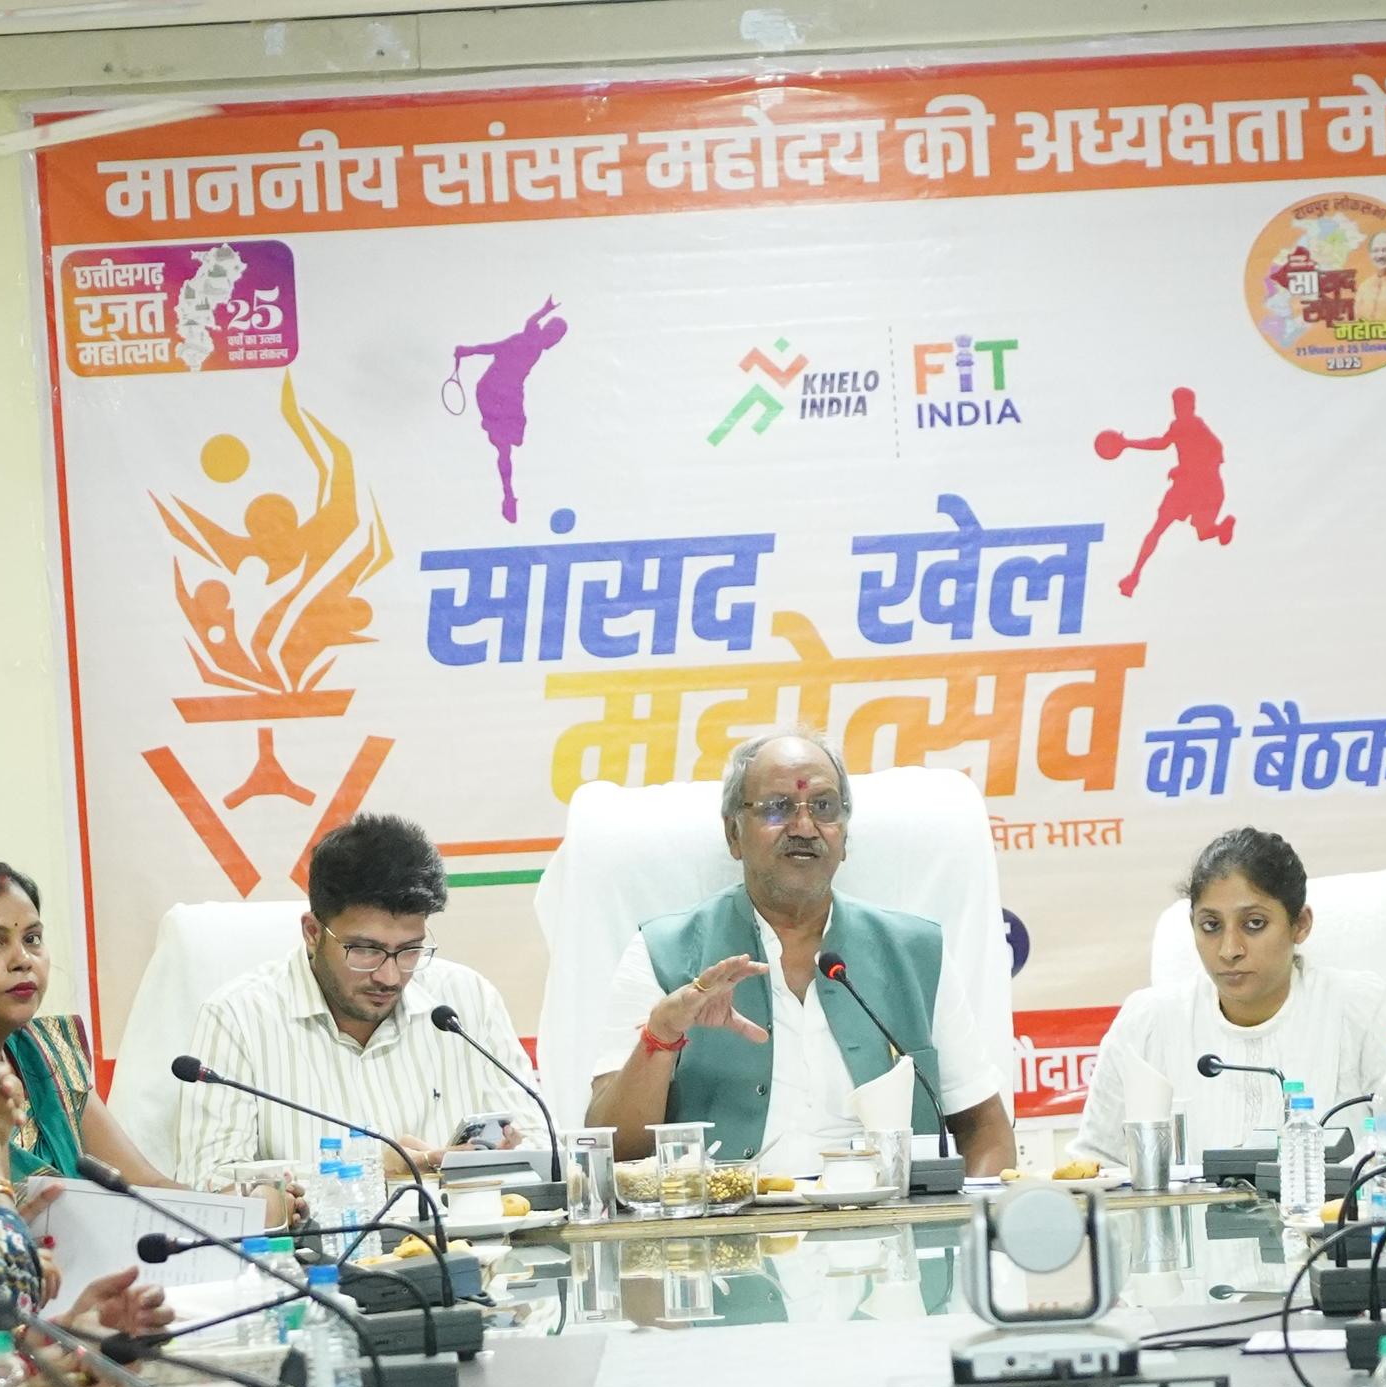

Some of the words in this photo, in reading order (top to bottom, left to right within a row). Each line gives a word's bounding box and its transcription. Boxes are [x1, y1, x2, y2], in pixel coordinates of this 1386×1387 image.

[97, 129, 404, 220] माननीय
[413, 121, 630, 207] सांसद
[637, 104, 886, 192] महोदय
[895, 93, 997, 180] की
[1014, 97, 1310, 173] अध्यक्षता
[73, 258, 166, 291] छत्तीसगढ़
[74, 292, 168, 337] रजत
[226, 285, 284, 331] 25
[76, 333, 171, 366] महोत्सव
[802, 369, 880, 396] KHELO
[799, 395, 868, 420] INDIA
[916, 397, 1022, 429] INDIA
[420, 507, 776, 667] सांसद
[851, 493, 1105, 646] खेल
[543, 610, 1147, 806] महोत्सव
[1144, 704, 1242, 798] की
[1044, 817, 1125, 849] भारत
